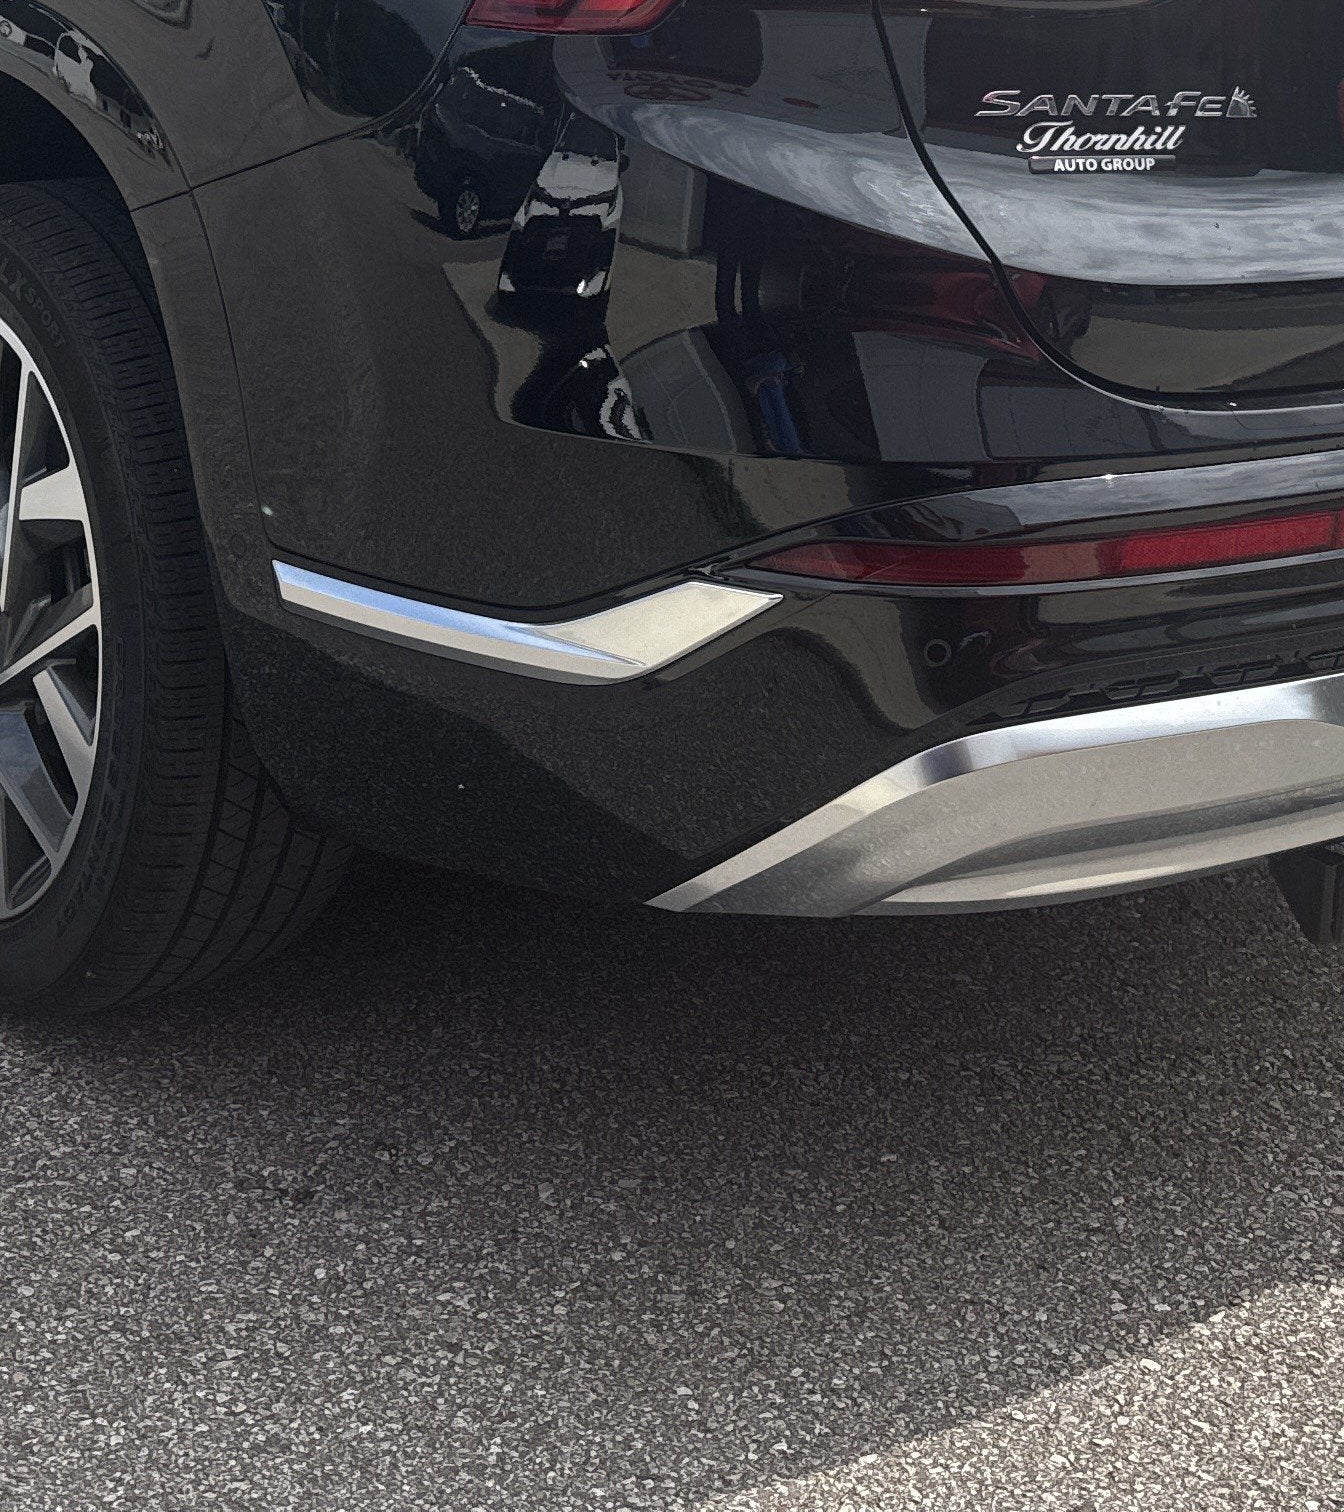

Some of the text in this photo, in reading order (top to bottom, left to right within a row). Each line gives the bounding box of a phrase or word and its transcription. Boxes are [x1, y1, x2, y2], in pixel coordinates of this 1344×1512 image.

[1016, 120, 1186, 153] Thornhill
[1053, 157, 1156, 172] AUTO GROUP
[24, 287, 66, 348] SPORT
